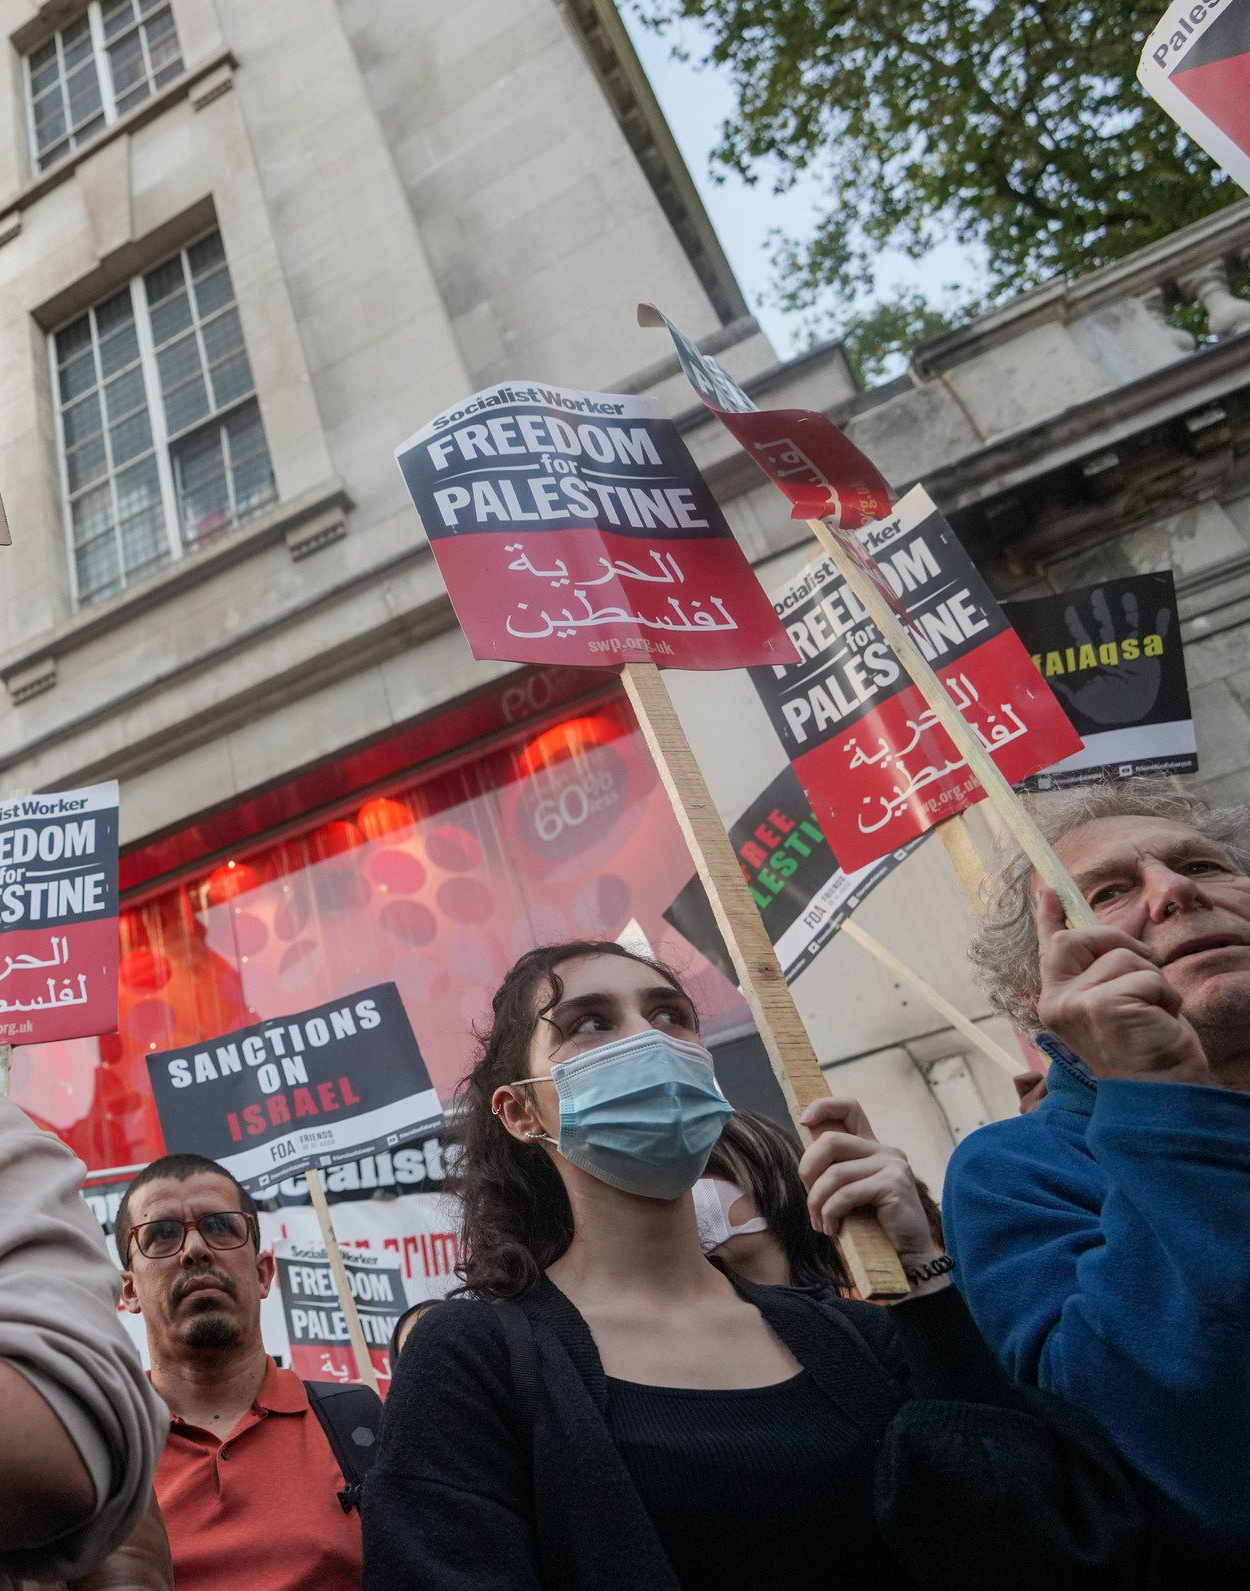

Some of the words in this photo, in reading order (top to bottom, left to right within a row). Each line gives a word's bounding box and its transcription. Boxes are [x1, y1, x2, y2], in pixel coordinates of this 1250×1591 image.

[426, 414, 663, 471] FREEDOM
[540, 453, 578, 475] for
[433, 476, 710, 529] PALESTINE
[504, 543, 684, 588] الحرية
[506, 590, 739, 639] لفلسطين
[845, 622, 877, 654] for
[587, 639, 675, 656] swp.org.uk
[781, 588, 990, 744] PALESINE
[739, 808, 796, 881] REE
[167, 999, 381, 1089] SANCTIONS
[257, 1055, 309, 1094] ON
[226, 1076, 361, 1143] ISRAEL
[270, 1140, 296, 1162] FOA
